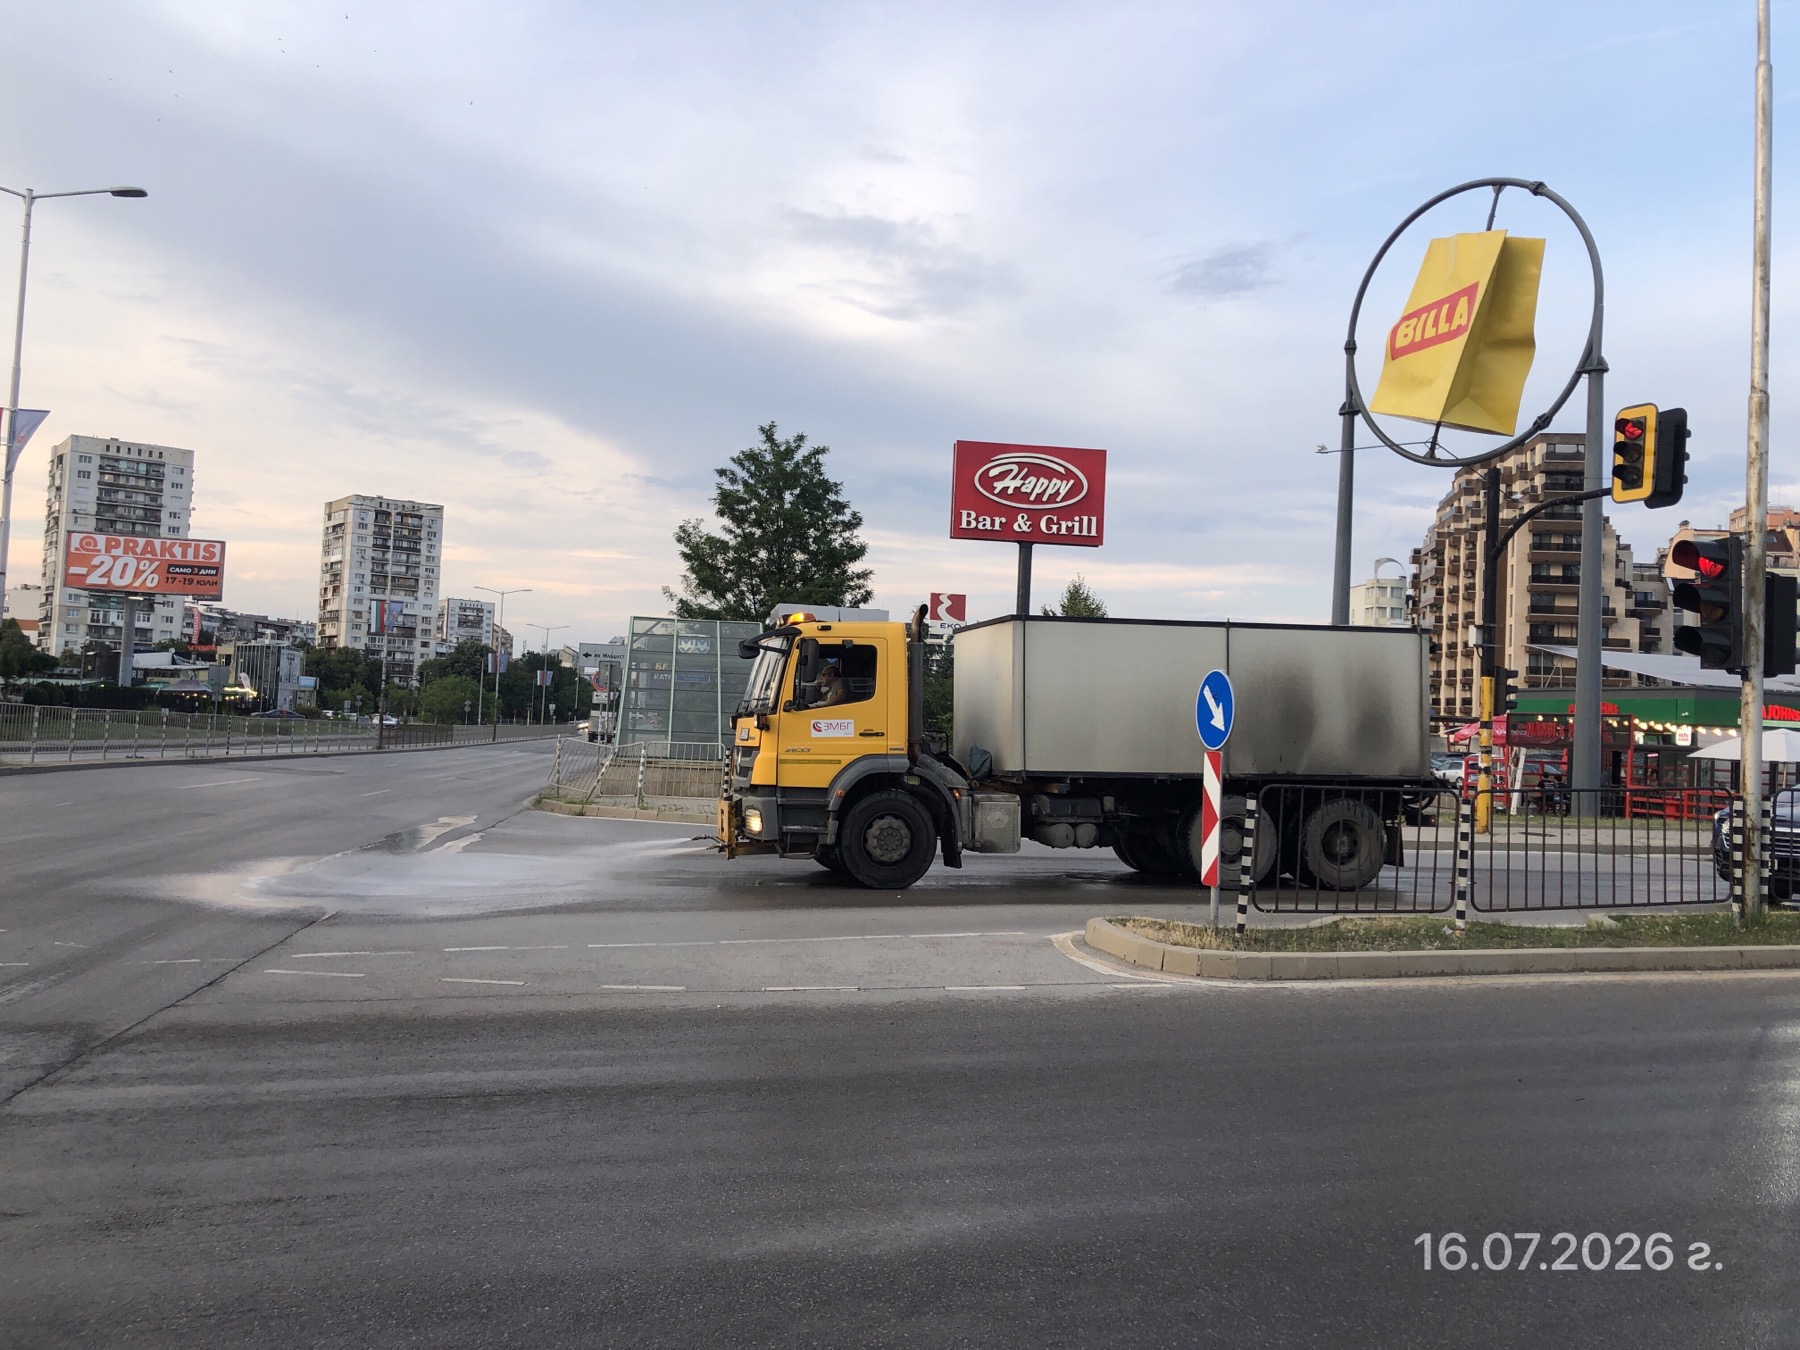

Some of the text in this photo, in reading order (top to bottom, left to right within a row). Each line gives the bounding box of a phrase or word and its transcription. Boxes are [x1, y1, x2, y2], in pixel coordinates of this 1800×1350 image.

[1395, 296, 1469, 349] BILLA
[988, 463, 1075, 502] Happy
[959, 509, 1098, 537] Bar & Grill
[104, 536, 217, 561] PRAKTIS
[68, 555, 160, 588] -20%
[169, 566, 192, 574] САМО
[196, 579, 218, 587] ЮЛИ
[823, 721, 853, 731] ЗМБГ
